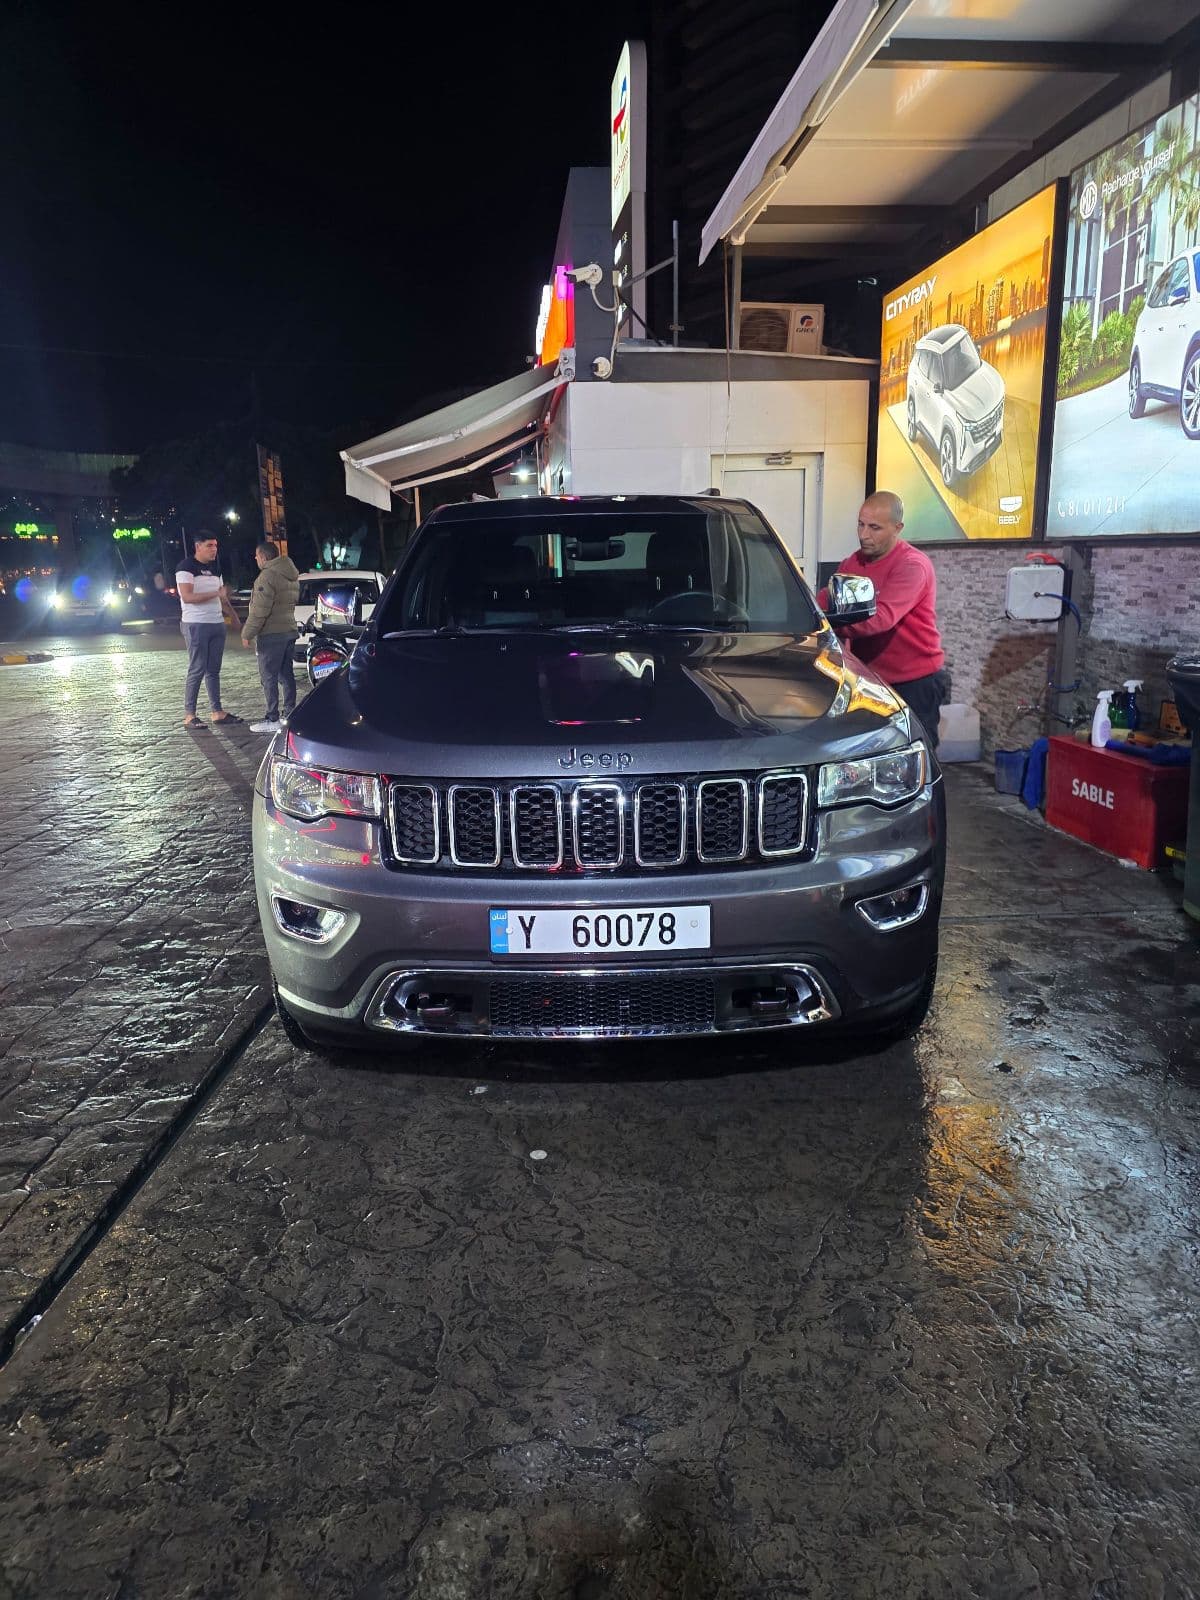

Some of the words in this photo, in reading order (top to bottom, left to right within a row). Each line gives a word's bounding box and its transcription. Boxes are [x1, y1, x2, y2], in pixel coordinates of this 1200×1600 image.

[1102, 167, 1140, 194] Recharge
[1139, 141, 1175, 180] yourself
[886, 275, 937, 321] CITYRAY
[998, 514, 1020, 525] GEELY
[558, 748, 633, 771] Jeep
[1072, 778, 1115, 810] SABLE
[491, 911, 507, 921] لبنان
[517, 915, 537, 949] Y
[572, 912, 677, 948] 60078
